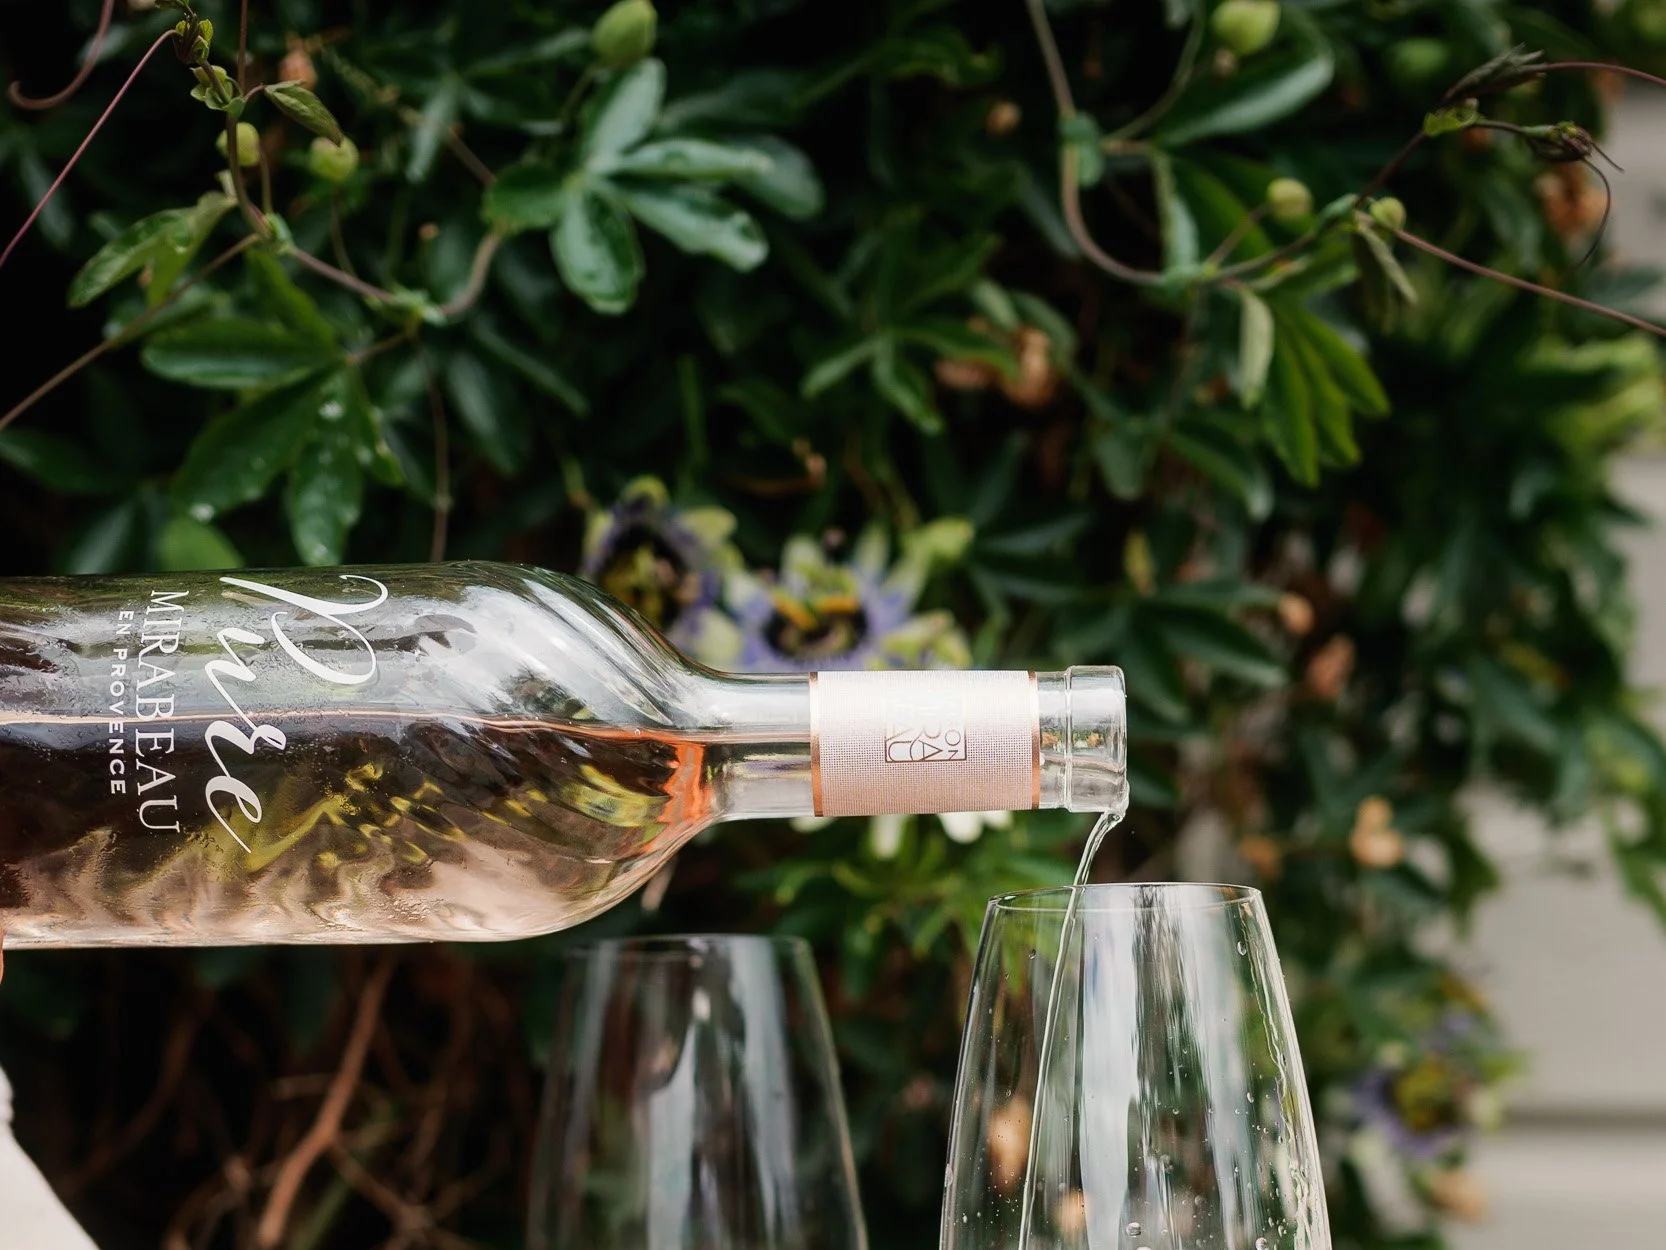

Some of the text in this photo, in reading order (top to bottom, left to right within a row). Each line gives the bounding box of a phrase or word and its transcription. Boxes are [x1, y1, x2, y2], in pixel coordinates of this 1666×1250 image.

[107, 610, 134, 795] EN PROVENCE
[135, 590, 190, 833] MIRABEAU
[204, 574, 389, 854] Pure
